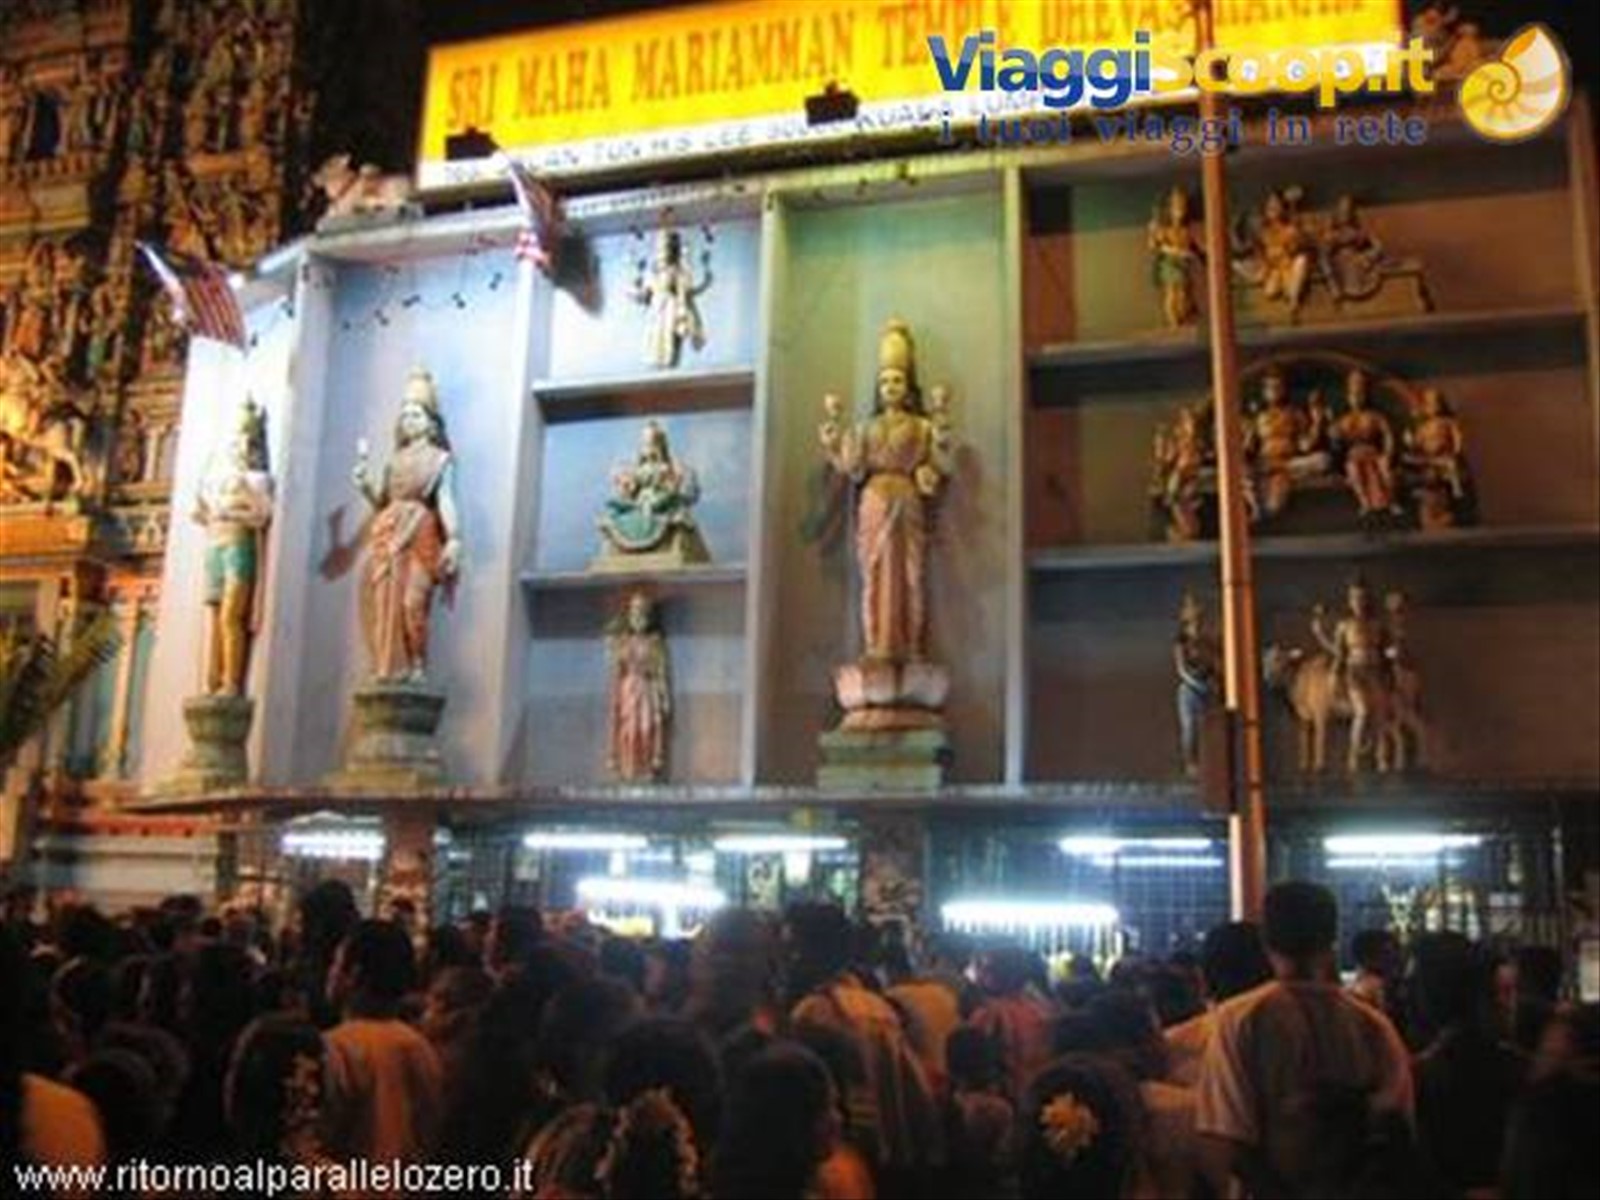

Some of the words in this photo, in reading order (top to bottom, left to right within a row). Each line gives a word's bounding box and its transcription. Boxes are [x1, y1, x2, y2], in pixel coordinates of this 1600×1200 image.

[448, 63, 500, 128] SRI
[513, 46, 609, 121] MAHA
[632, 8, 857, 103] MARIAMMAN
